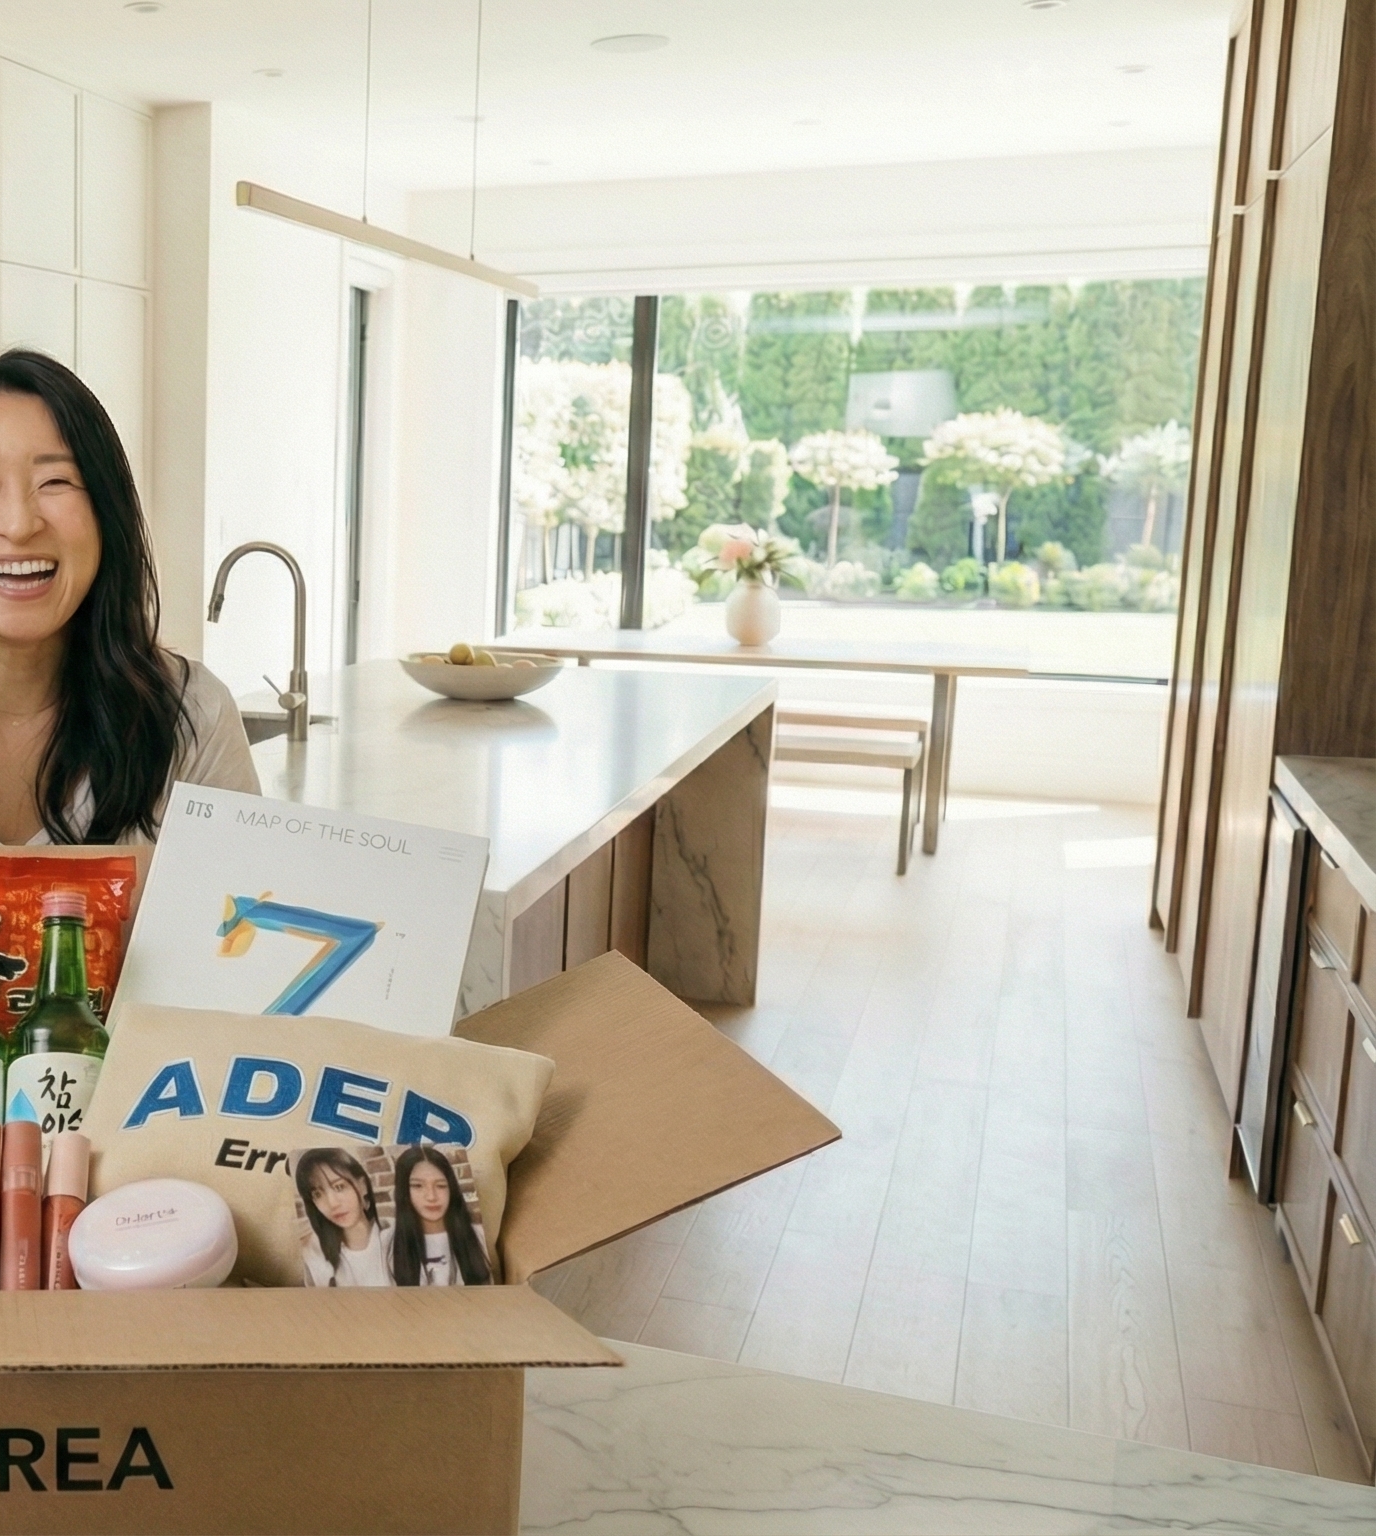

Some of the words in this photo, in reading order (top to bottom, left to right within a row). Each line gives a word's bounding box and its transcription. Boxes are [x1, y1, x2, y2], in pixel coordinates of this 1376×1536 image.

[235, 809, 282, 830] MAP
[285, 818, 313, 835] OF
[318, 823, 356, 845] THE
[358, 831, 412, 856] SOUL
[37, 1066, 77, 1109] 참
[214, 1137, 292, 1178] Err
